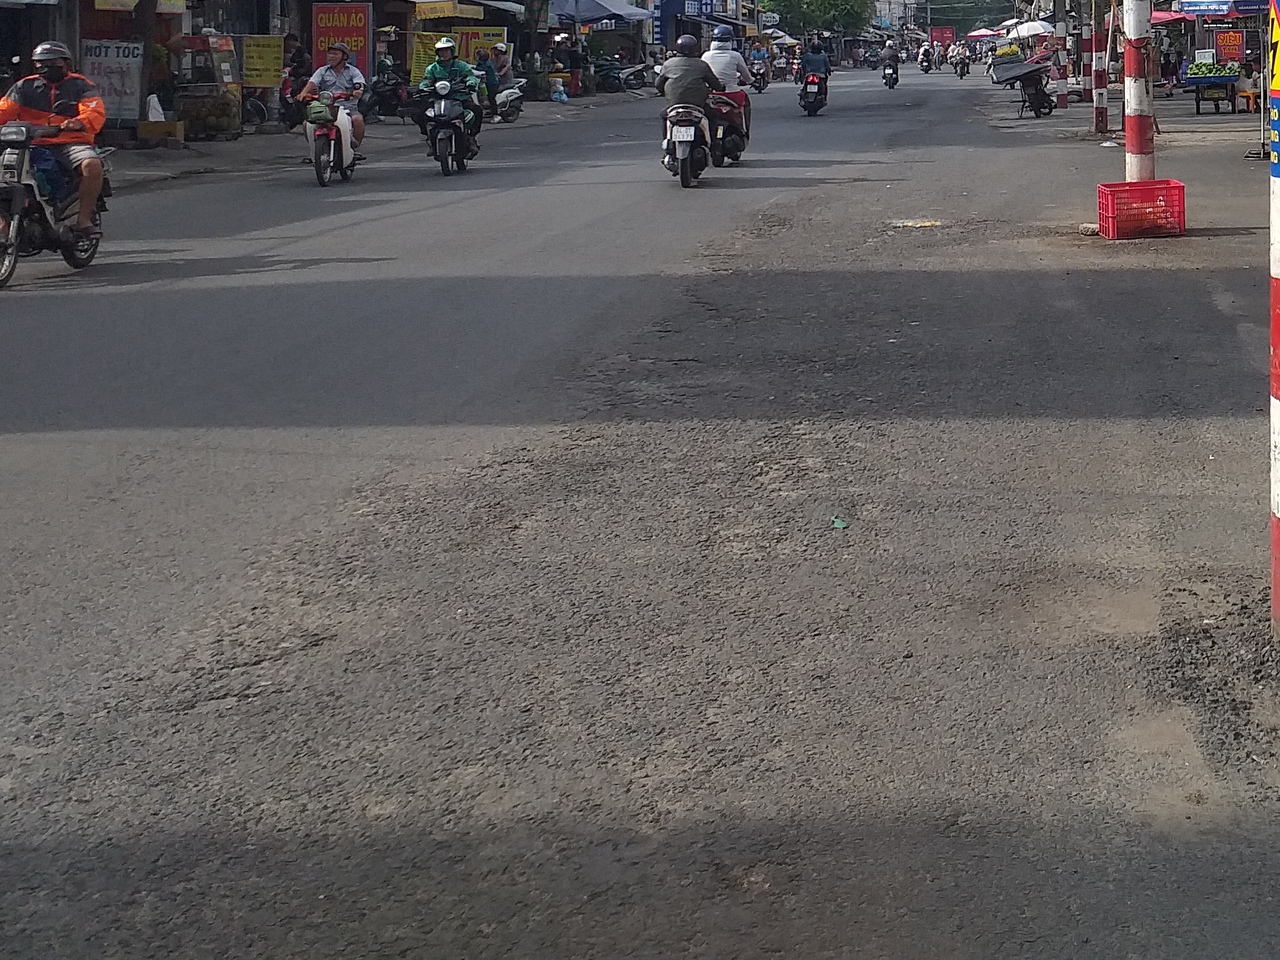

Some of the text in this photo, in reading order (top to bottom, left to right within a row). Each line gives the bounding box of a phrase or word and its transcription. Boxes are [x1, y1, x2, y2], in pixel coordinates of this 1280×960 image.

[317, 7, 365, 28] QUẦN ÁO
[349, 32, 365, 52] DÉP
[1217, 32, 1242, 46] SIÊU
